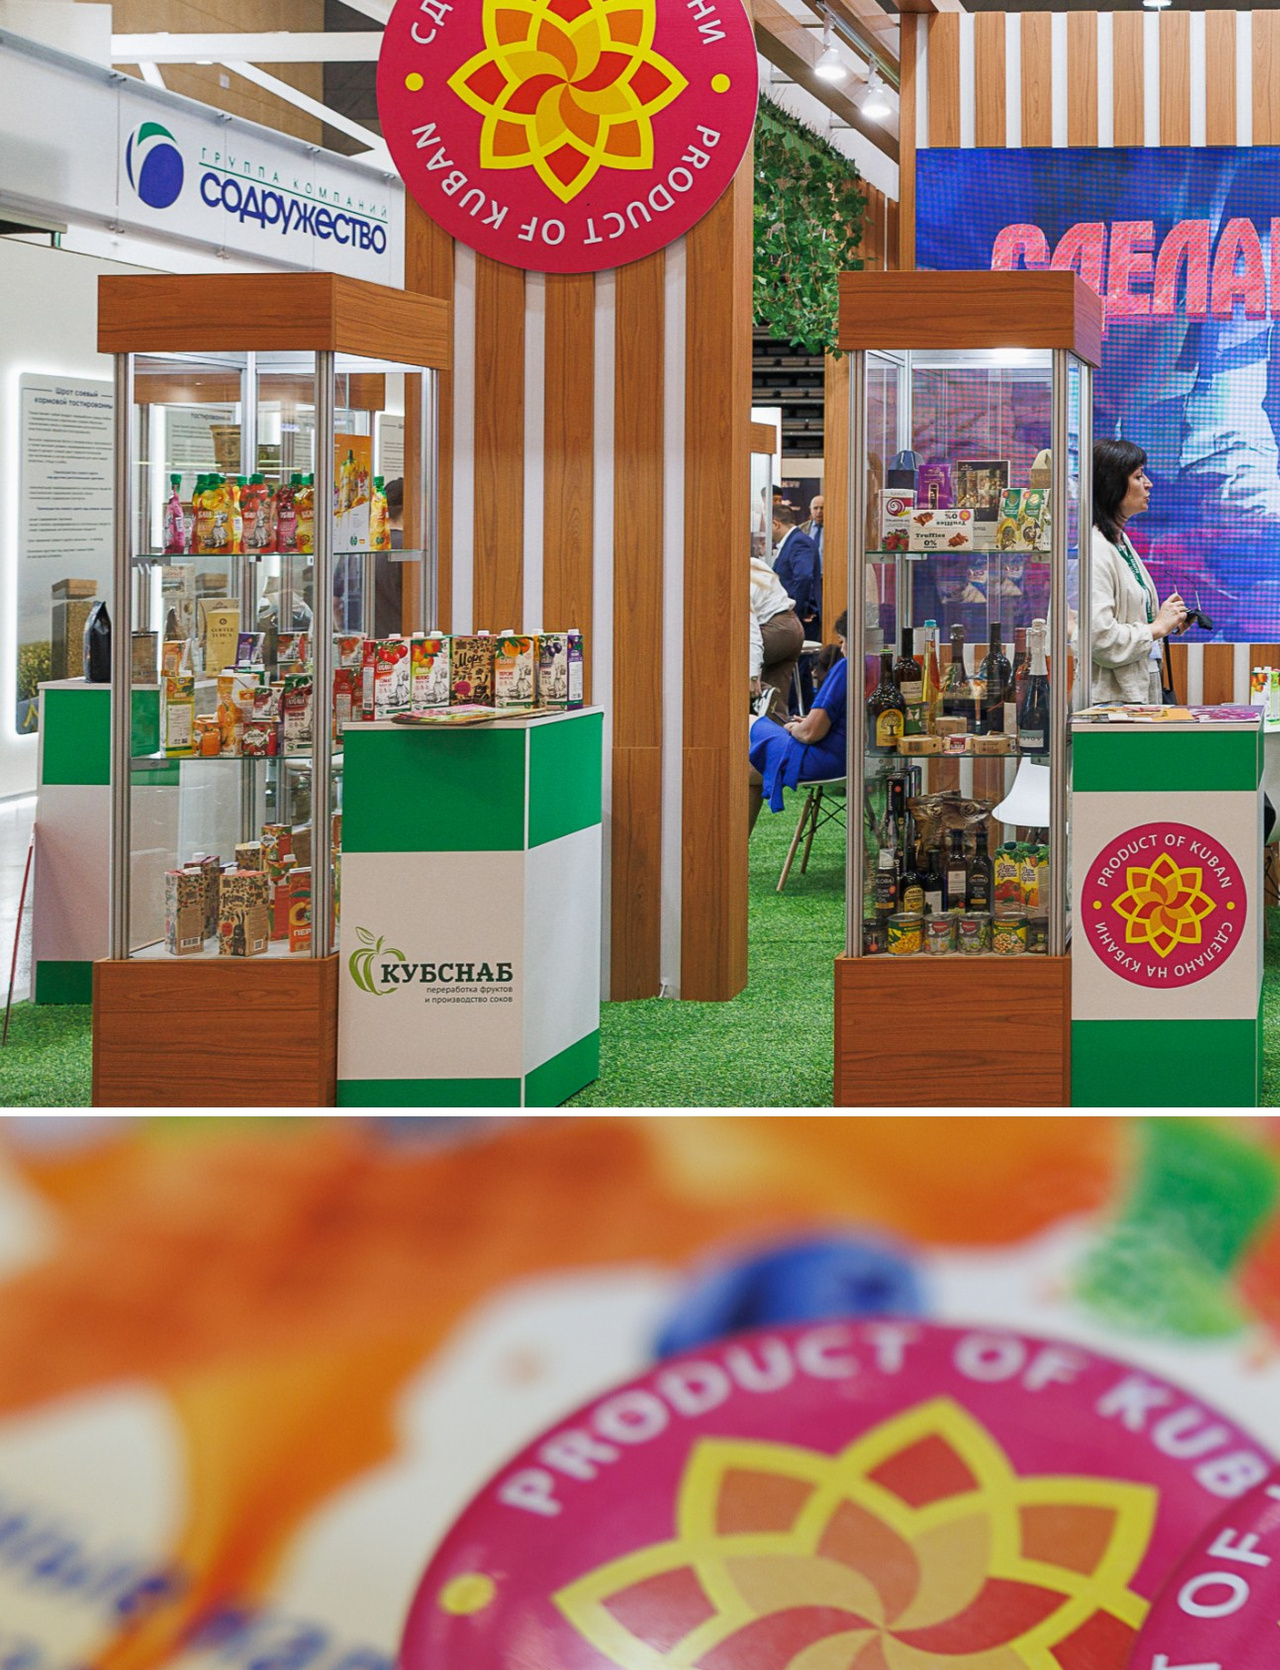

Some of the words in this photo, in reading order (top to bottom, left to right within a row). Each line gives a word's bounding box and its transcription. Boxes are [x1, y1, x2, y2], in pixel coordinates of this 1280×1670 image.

[201, 147, 279, 183] ГРУППА
[293, 178, 388, 219] КОМПАНИЙ
[412, 122, 509, 230] KUBAN
[583, 125, 721, 245] PRODUCT
[518, 216, 566, 245] OF
[1097, 834, 1158, 887] PRODUCT
[1164, 834, 1186, 848] OF
[1189, 841, 1232, 889] KUBAN
[293, 928, 312, 936] ПЕР
[1095, 921, 1142, 973] КУБАНИ
[1174, 921, 1233, 977] СДЕЛАНО
[381, 963, 513, 983] КУБСНАБ
[426, 986, 478, 994] переработка
[480, 986, 513, 994] фруктов
[1147, 965, 1168, 978] НА
[432, 996, 488, 1004] производство
[499, 1325, 914, 1517] PRODUCT
[953, 1334, 1086, 1391] OF
[1098, 1377, 1268, 1500] KUB
[1177, 1528, 1273, 1619] OF
